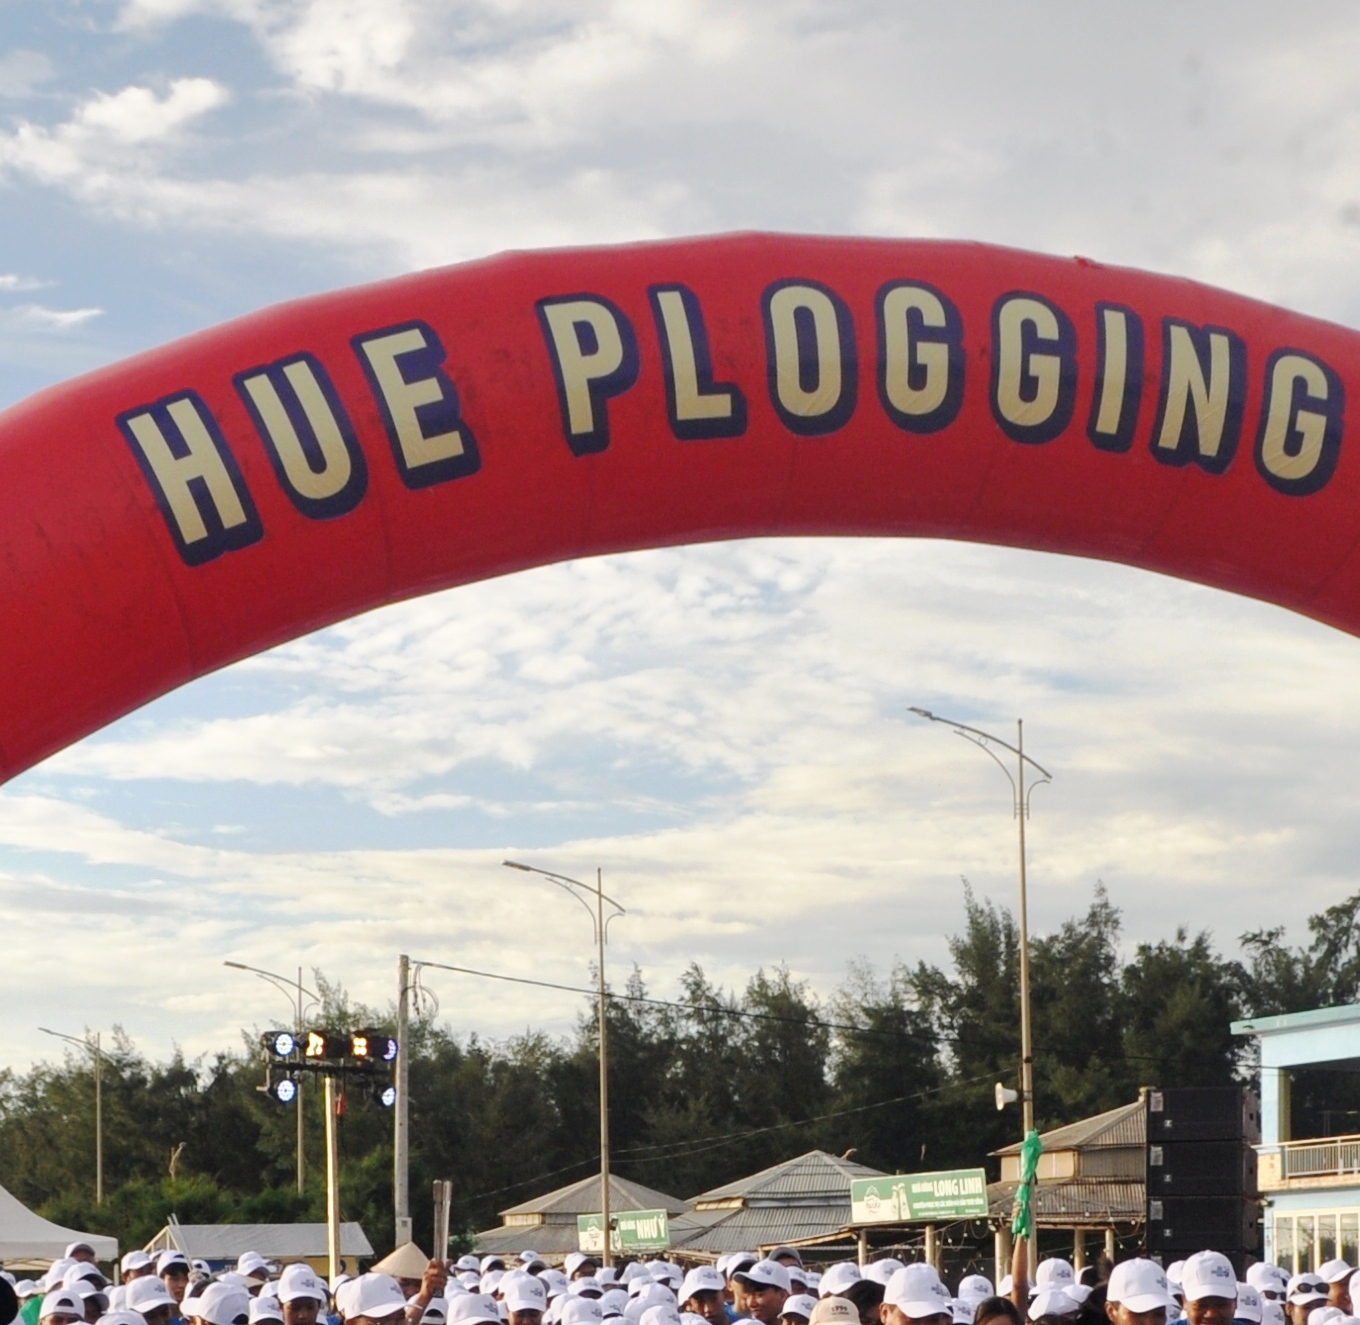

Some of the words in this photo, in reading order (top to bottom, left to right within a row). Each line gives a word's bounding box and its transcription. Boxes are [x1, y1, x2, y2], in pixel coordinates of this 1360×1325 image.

[116, 318, 481, 566] HUE
[534, 276, 1344, 496] PLOGGING
[934, 1179, 959, 1197] LONG
[959, 1176, 983, 1195] LINH
